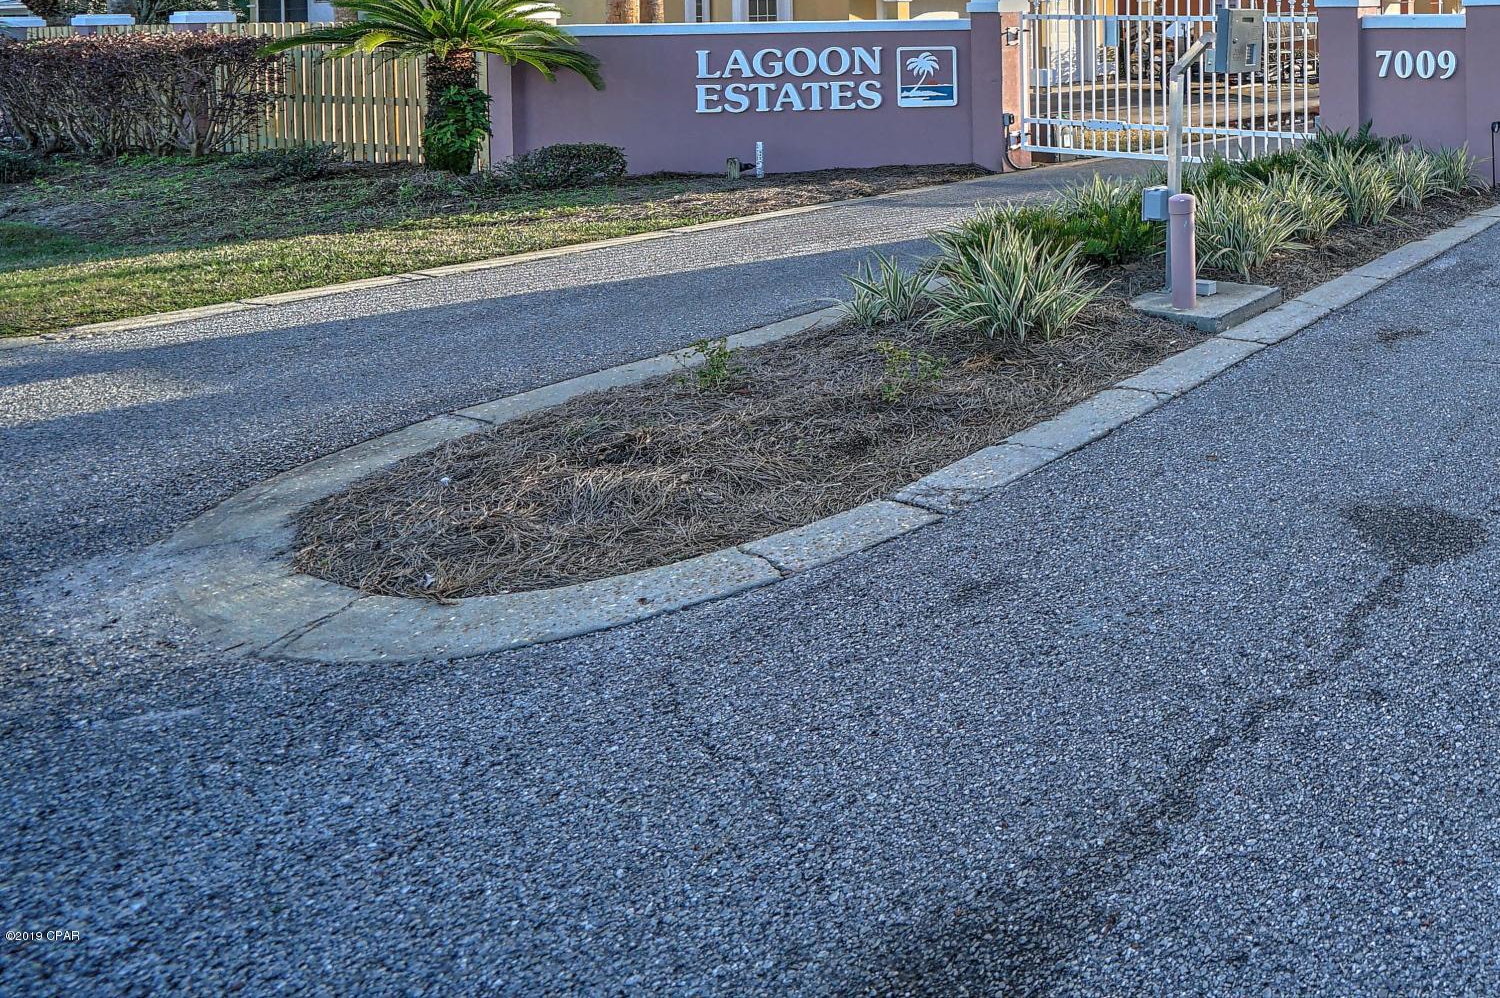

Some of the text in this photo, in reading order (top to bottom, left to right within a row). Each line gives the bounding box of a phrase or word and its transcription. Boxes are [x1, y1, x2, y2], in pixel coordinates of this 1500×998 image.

[695, 46, 883, 79] LAGOON
[1375, 50, 1457, 80] 7009
[695, 80, 883, 113] ESTATES
